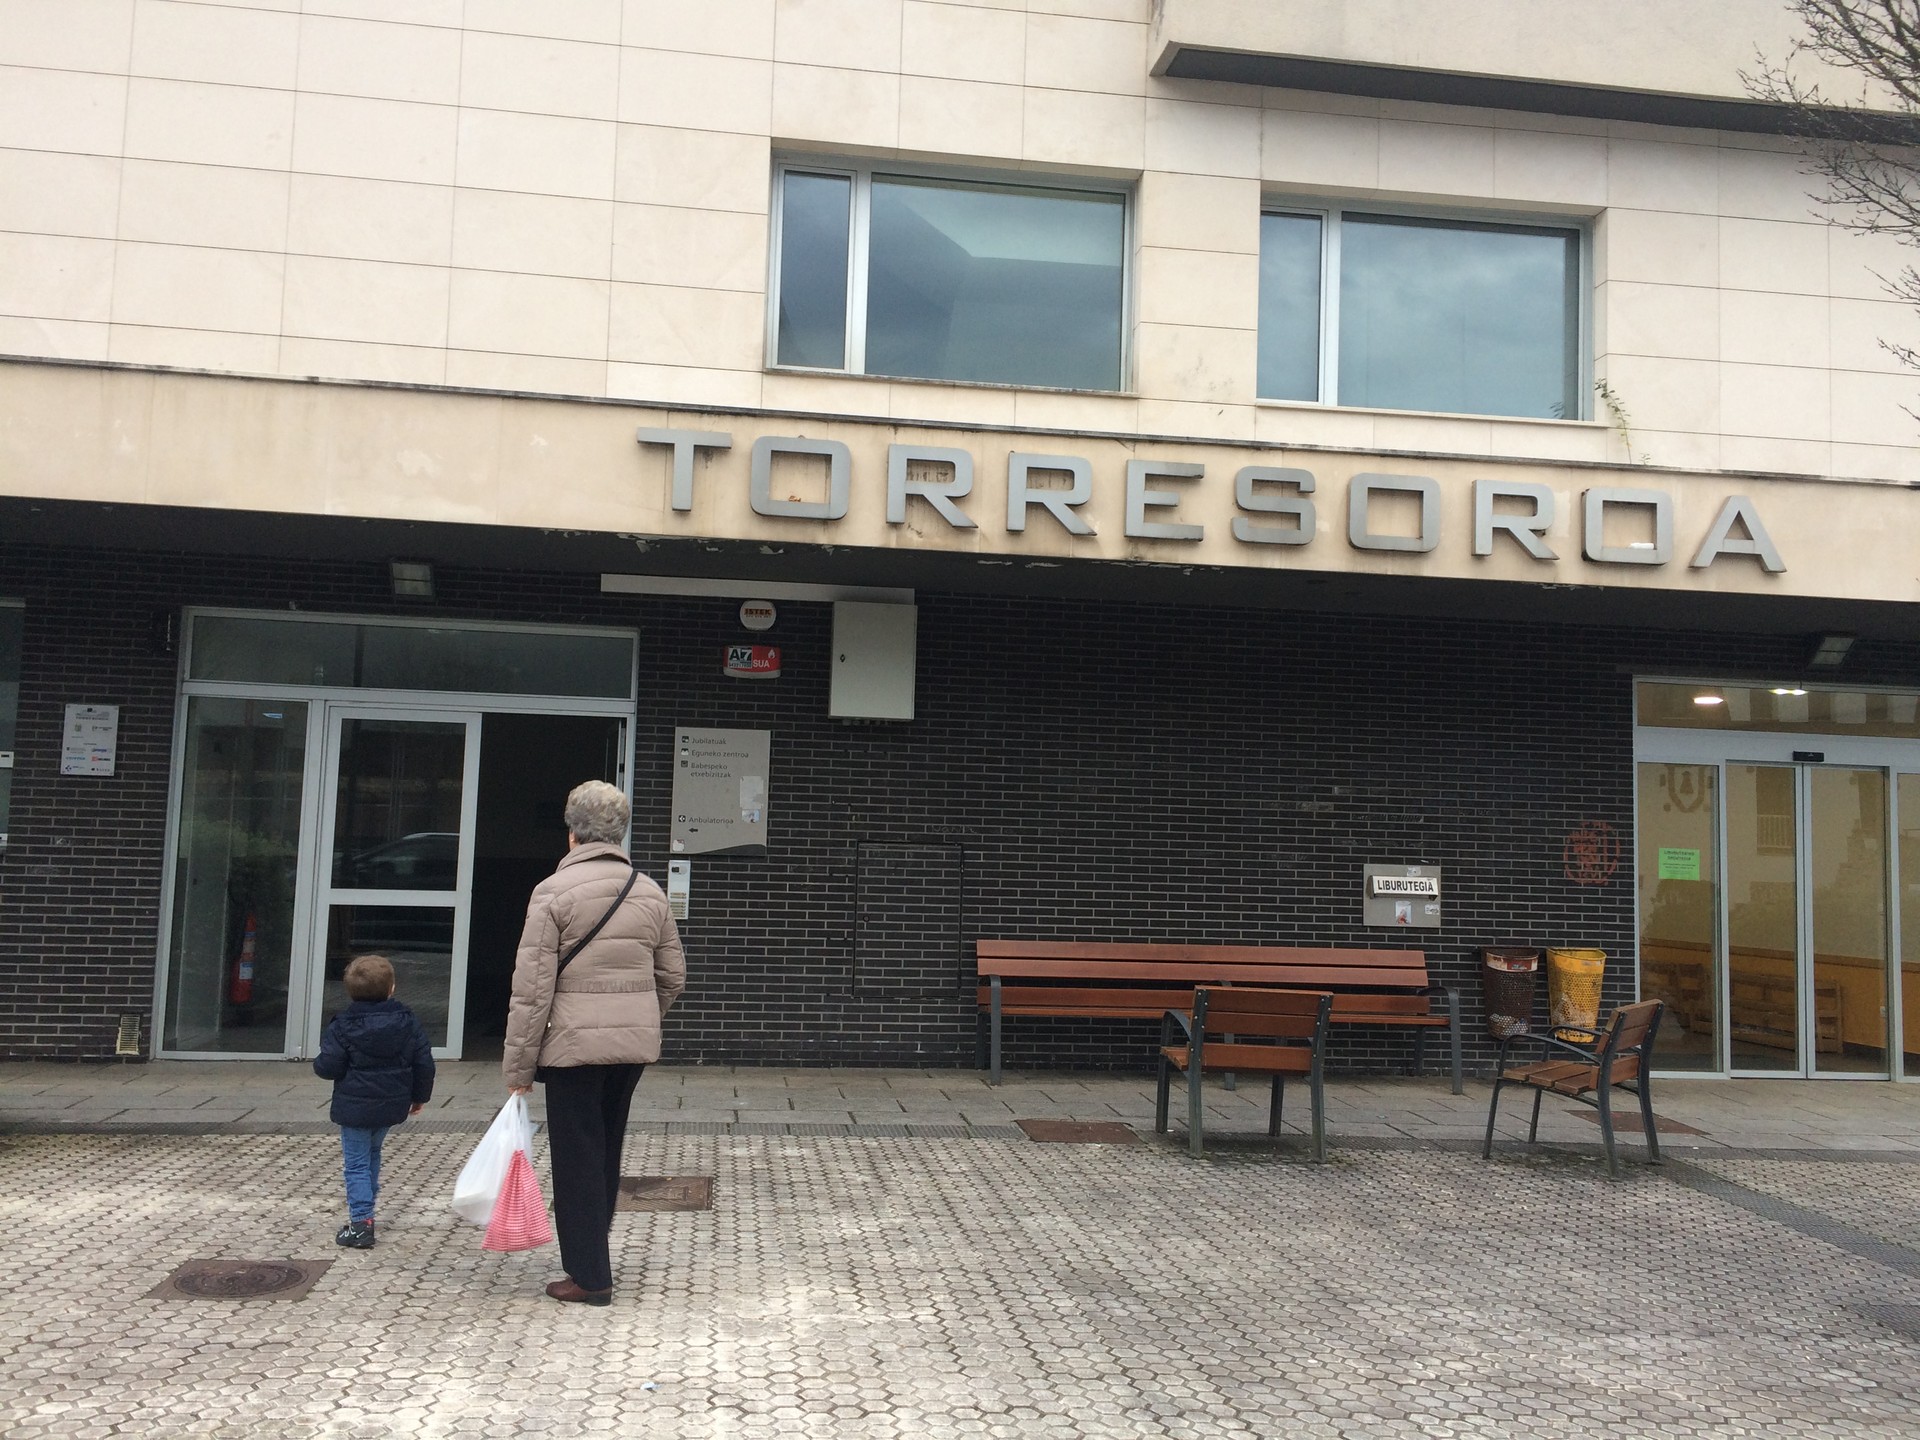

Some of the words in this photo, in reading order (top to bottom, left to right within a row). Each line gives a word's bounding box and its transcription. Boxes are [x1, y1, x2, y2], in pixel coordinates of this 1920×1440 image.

[637, 426, 1787, 573] TORRESOROA
[752, 659, 770, 668] SUA
[691, 750, 722, 758] Eguneko
[691, 762, 728, 770] Babespeko
[1377, 880, 1434, 892] LIBURUTEGIA
